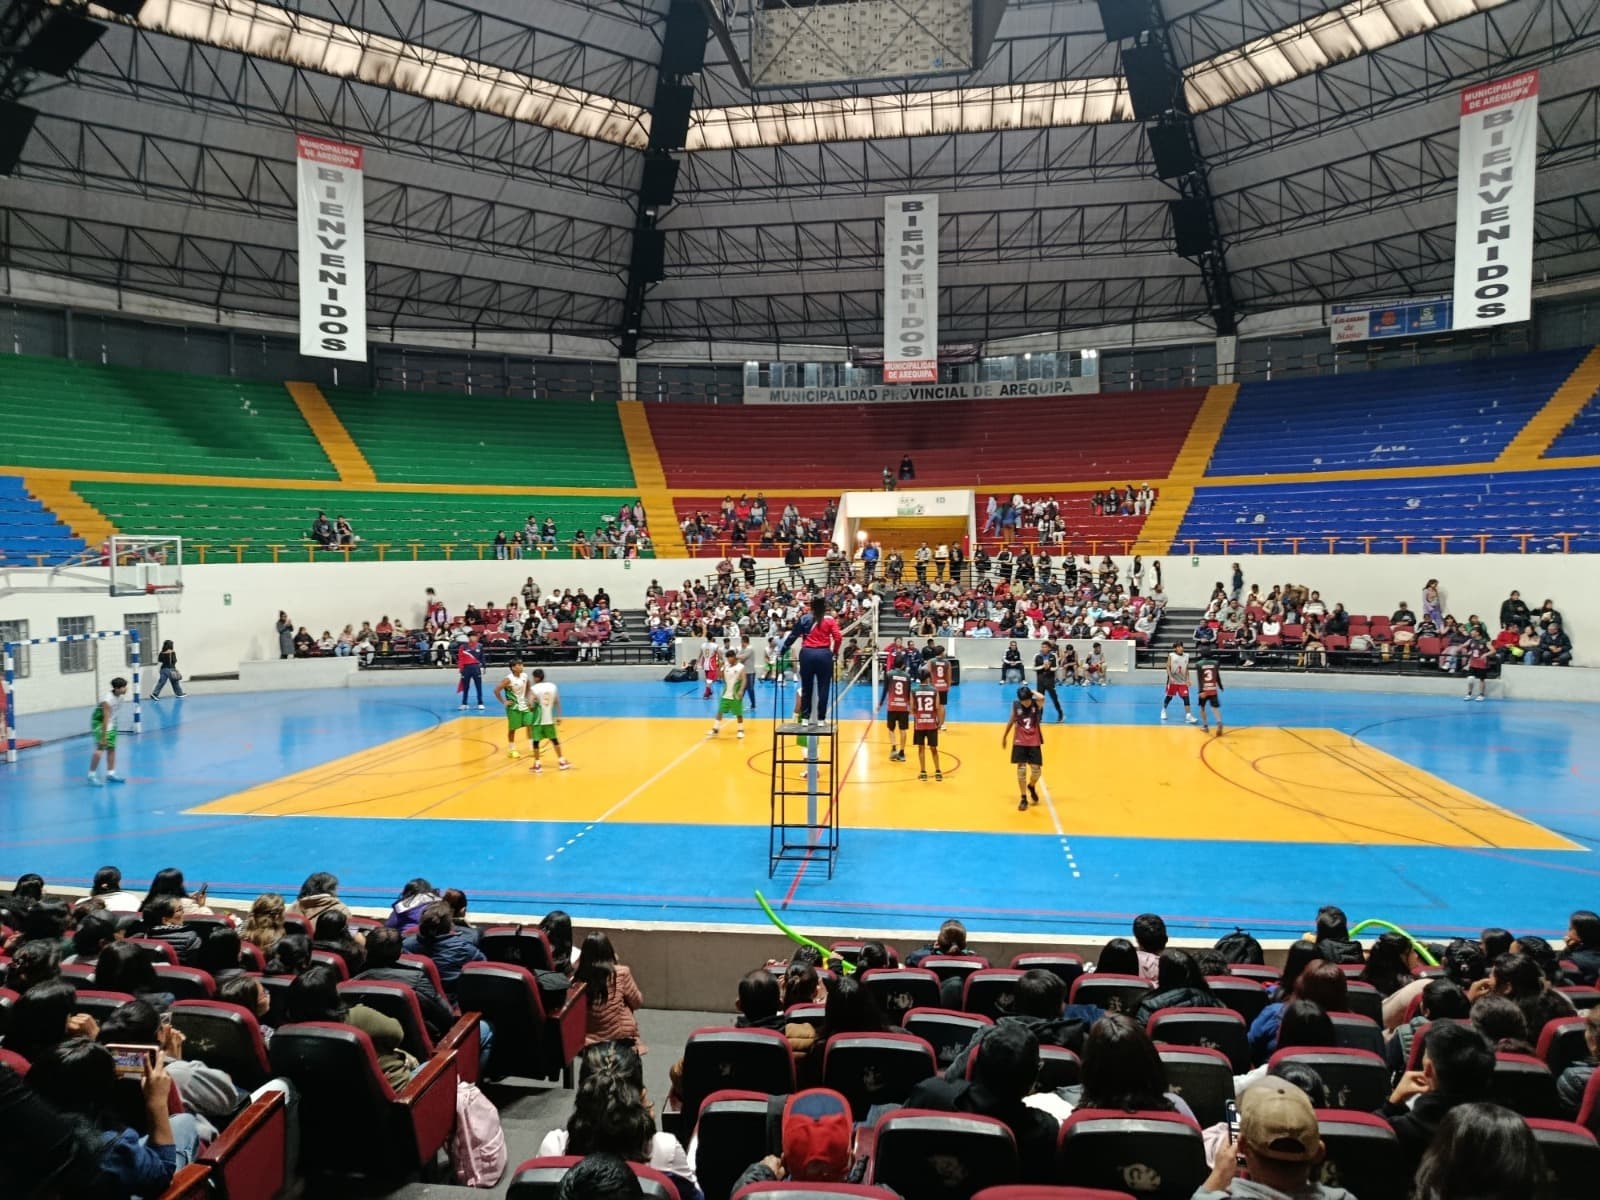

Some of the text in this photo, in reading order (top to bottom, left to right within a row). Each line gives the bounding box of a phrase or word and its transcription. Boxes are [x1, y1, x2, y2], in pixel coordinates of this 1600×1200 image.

[1464, 75, 1534, 101] MUNICIPALIDAD
[1469, 87, 1529, 110] DE AREQUIPA
[299, 137, 360, 158] MUNICIPALIDAD
[1475, 109, 1514, 318] BIENVENIDOS
[316, 167, 349, 352] BIENVENIDOS
[900, 201, 925, 357] BIENVENIDOS
[769, 381, 1073, 402] MUNICIPALIDAD PROVINCIAL DE AREQUIPA
[937, 666, 944, 678] 8
[1204, 669, 1213, 681] 3
[895, 682, 904, 695] 9
[917, 697, 934, 711] 12
[1023, 718, 1031, 729] 7
